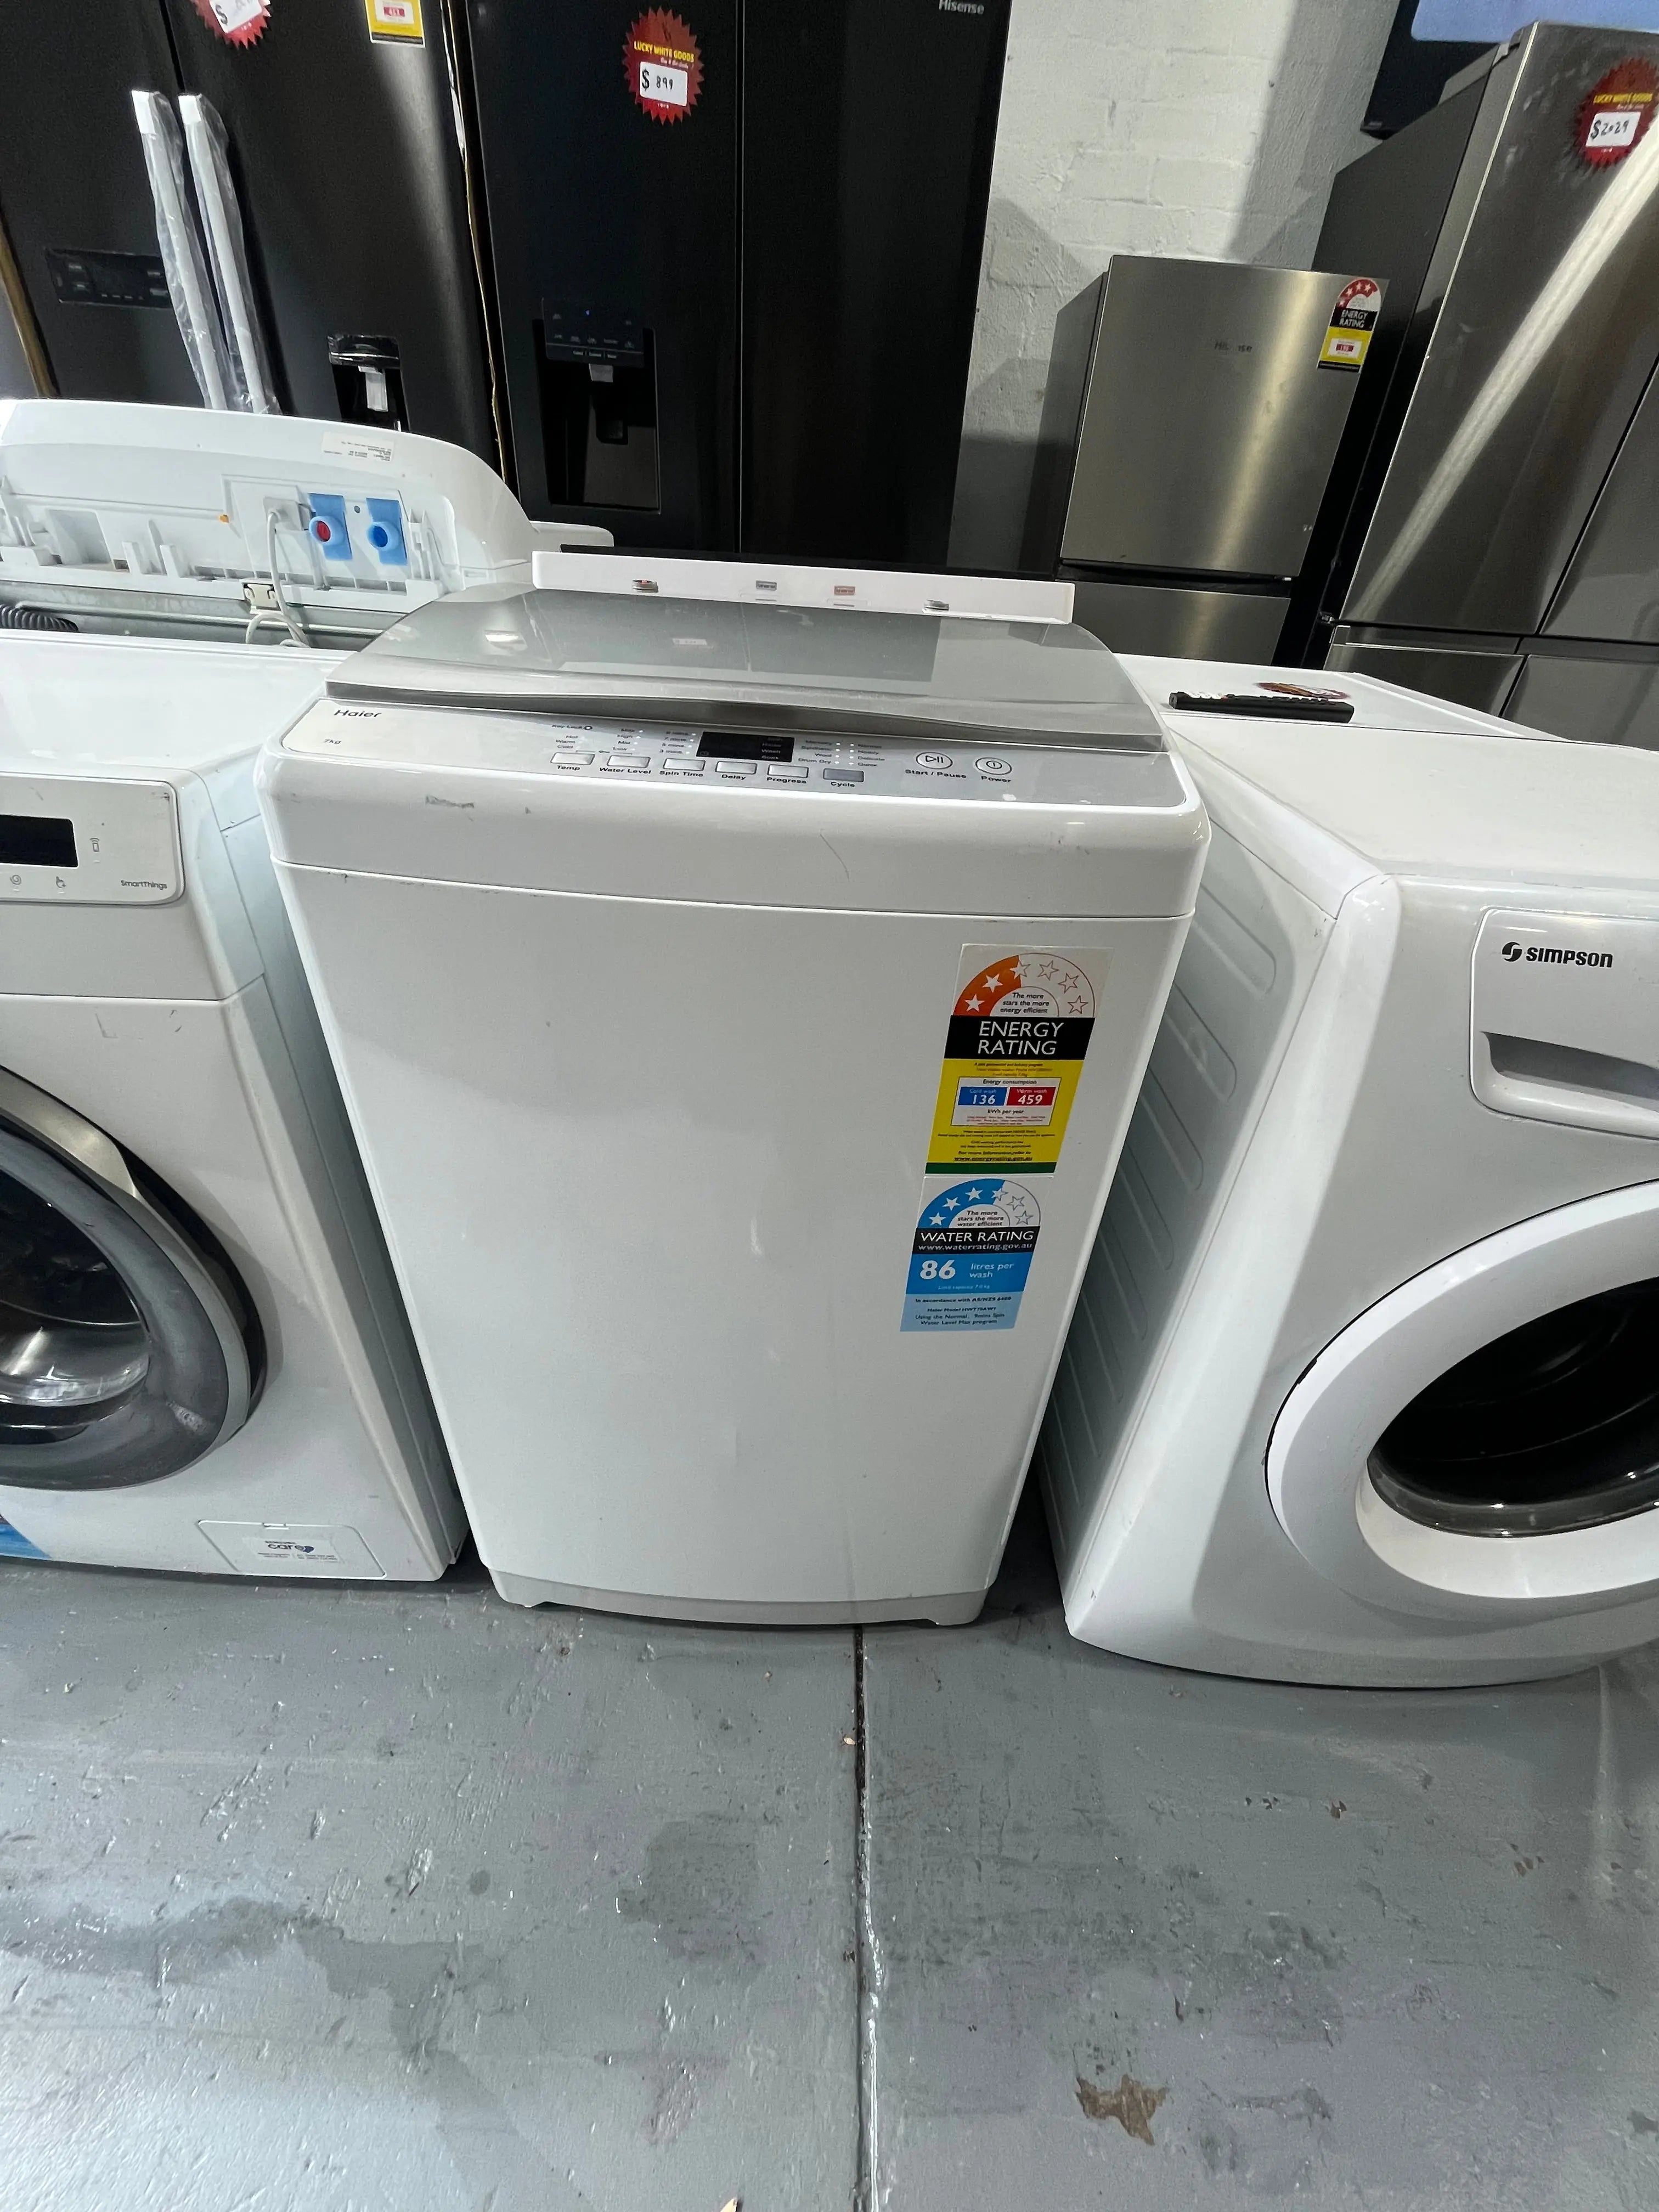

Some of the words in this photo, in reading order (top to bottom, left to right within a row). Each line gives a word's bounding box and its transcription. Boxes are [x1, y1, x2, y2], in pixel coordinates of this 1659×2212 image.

[939, 0, 984, 14] Hisense
[634, 40, 653, 54] LUCKY
[653, 45, 673, 58] WHITE
[673, 50, 695, 63] GOODS
[642, 68, 650, 91] $
[656, 75, 673, 91] 899
[1341, 309, 1368, 320] ENERGY
[1339, 318, 1365, 328] RATING
[121, 880, 167, 890] SmartThings
[979, 1021, 1064, 1037] ENERGY
[978, 1040, 1057, 1056] RATING
[973, 1094, 995, 1105] 136
[1018, 1094, 1043, 1105] 459
[921, 1232, 972, 1242] WATER
[978, 1231, 1034, 1242] RATING
[918, 1243, 1032, 1251] www.waterrating.gov.au
[919, 1260, 956, 1280] 86
